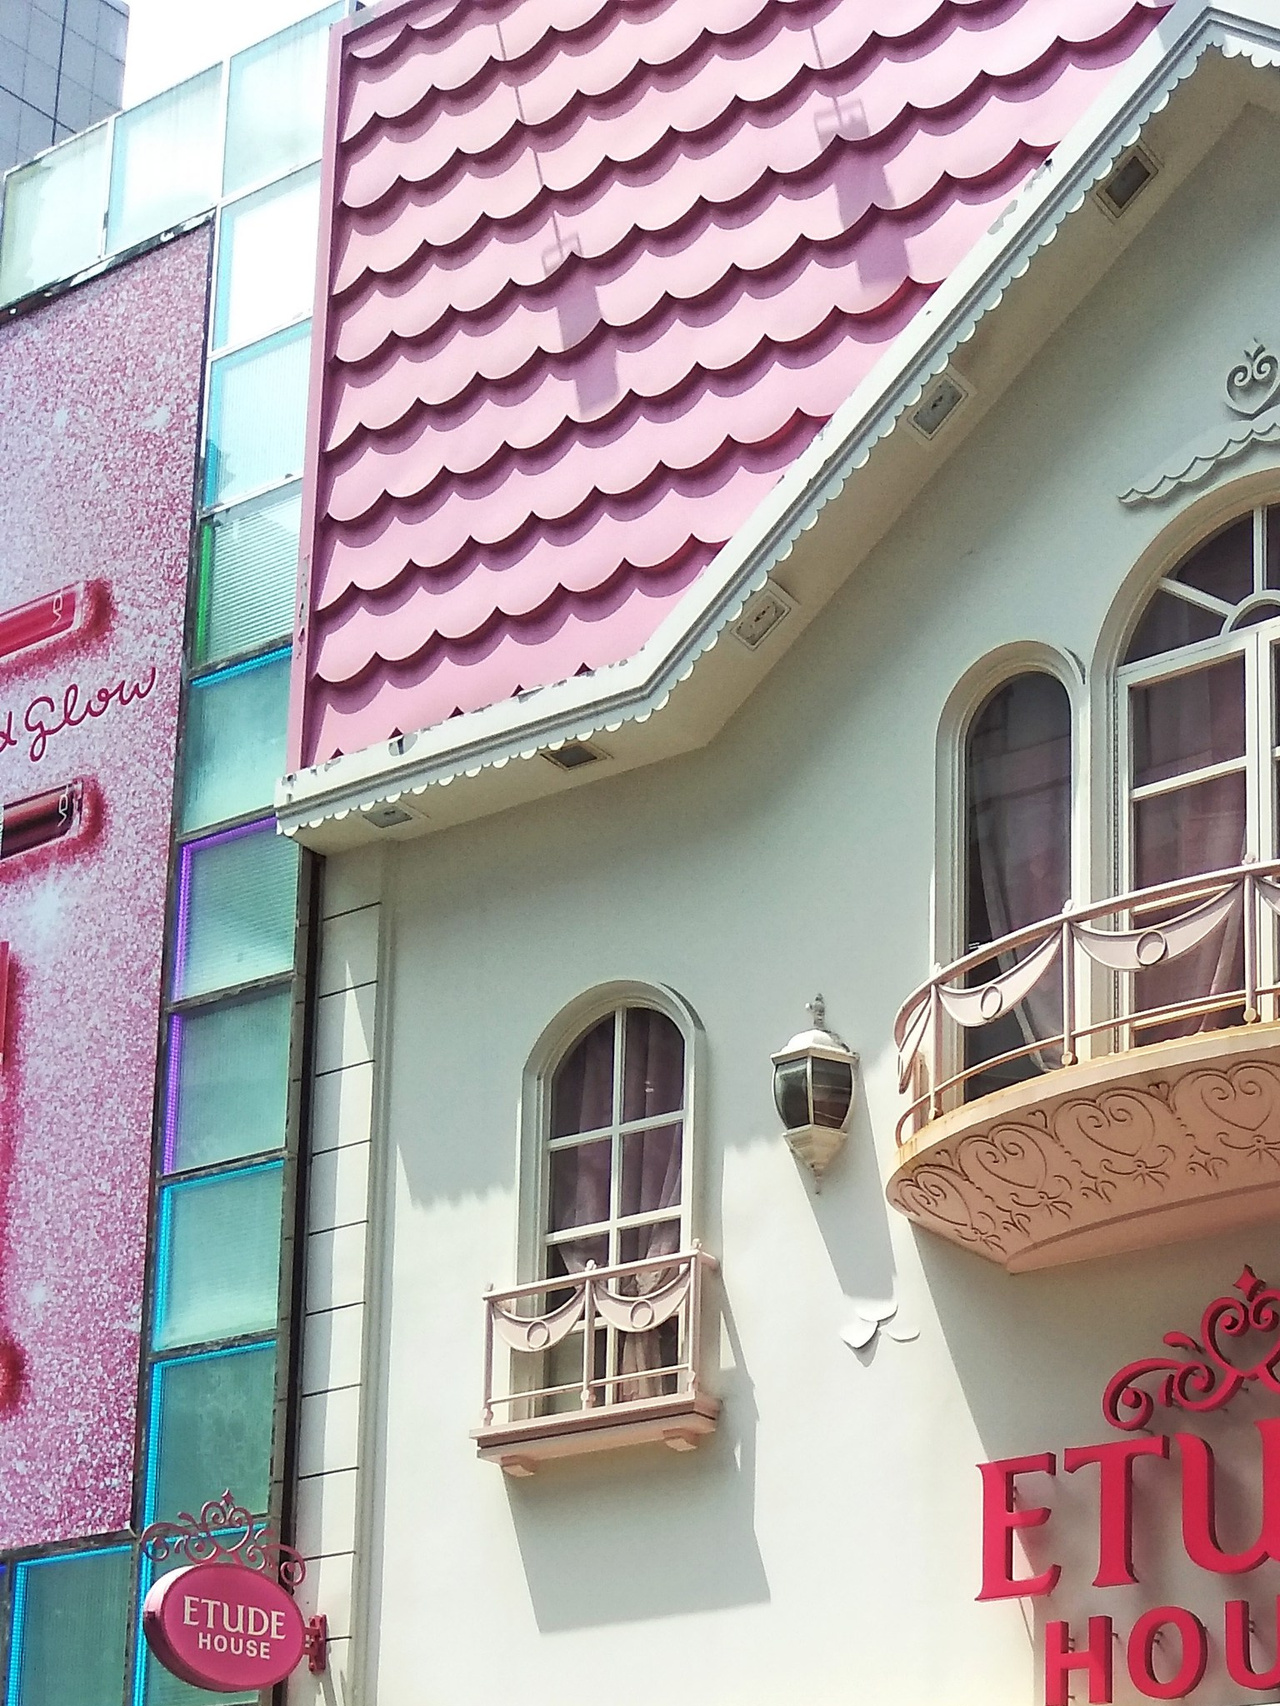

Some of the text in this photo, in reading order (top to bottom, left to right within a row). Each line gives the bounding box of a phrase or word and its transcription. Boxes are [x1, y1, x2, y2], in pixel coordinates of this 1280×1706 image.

[25, 667, 156, 761] Glow
[183, 1595, 286, 1640] ETUDE
[198, 1632, 271, 1660] HOUSE
